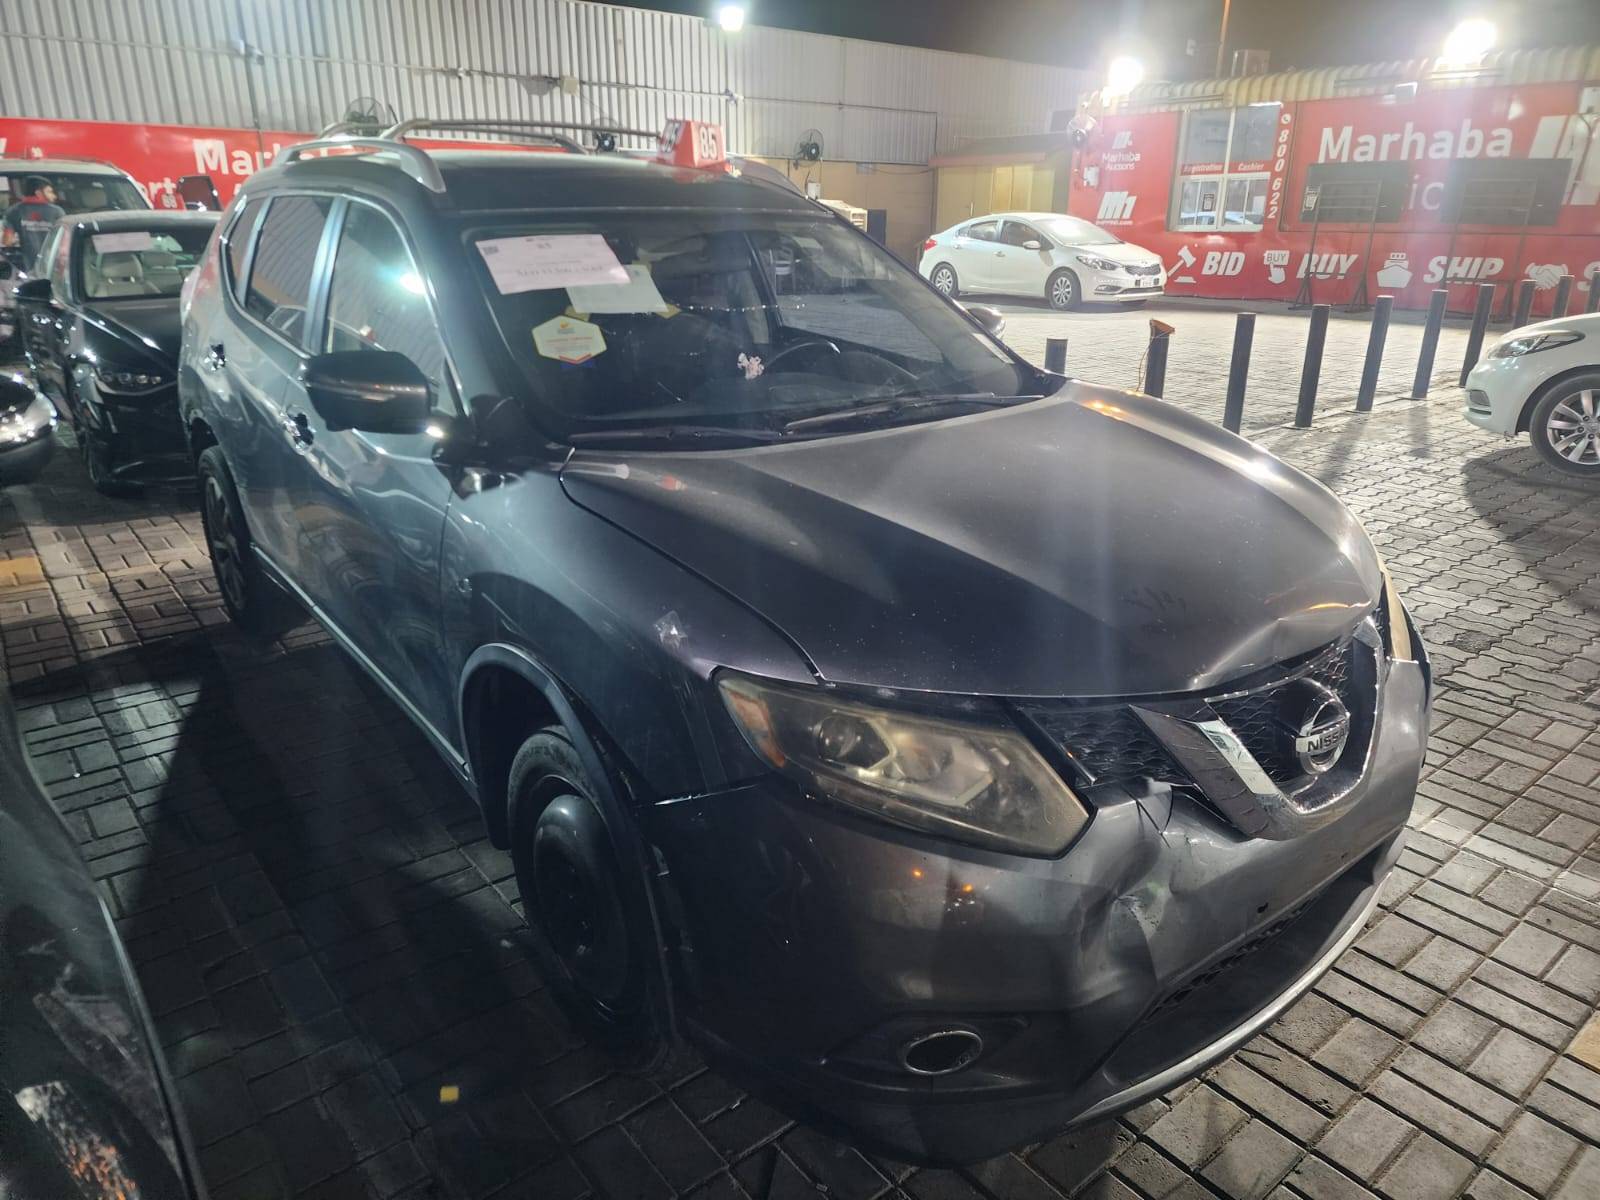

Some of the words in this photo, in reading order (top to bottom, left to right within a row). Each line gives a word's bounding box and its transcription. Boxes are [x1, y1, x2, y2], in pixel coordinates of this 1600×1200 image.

[700, 126, 718, 160] 85
[1275, 129, 1290, 172] 800
[1318, 119, 1513, 163] Marhaba
[1267, 178, 1283, 219] 622
[1202, 251, 1245, 276] BID
[1267, 253, 1286, 262] BUY
[1297, 254, 1358, 280] BUY
[1423, 256, 1504, 285] SHIP
